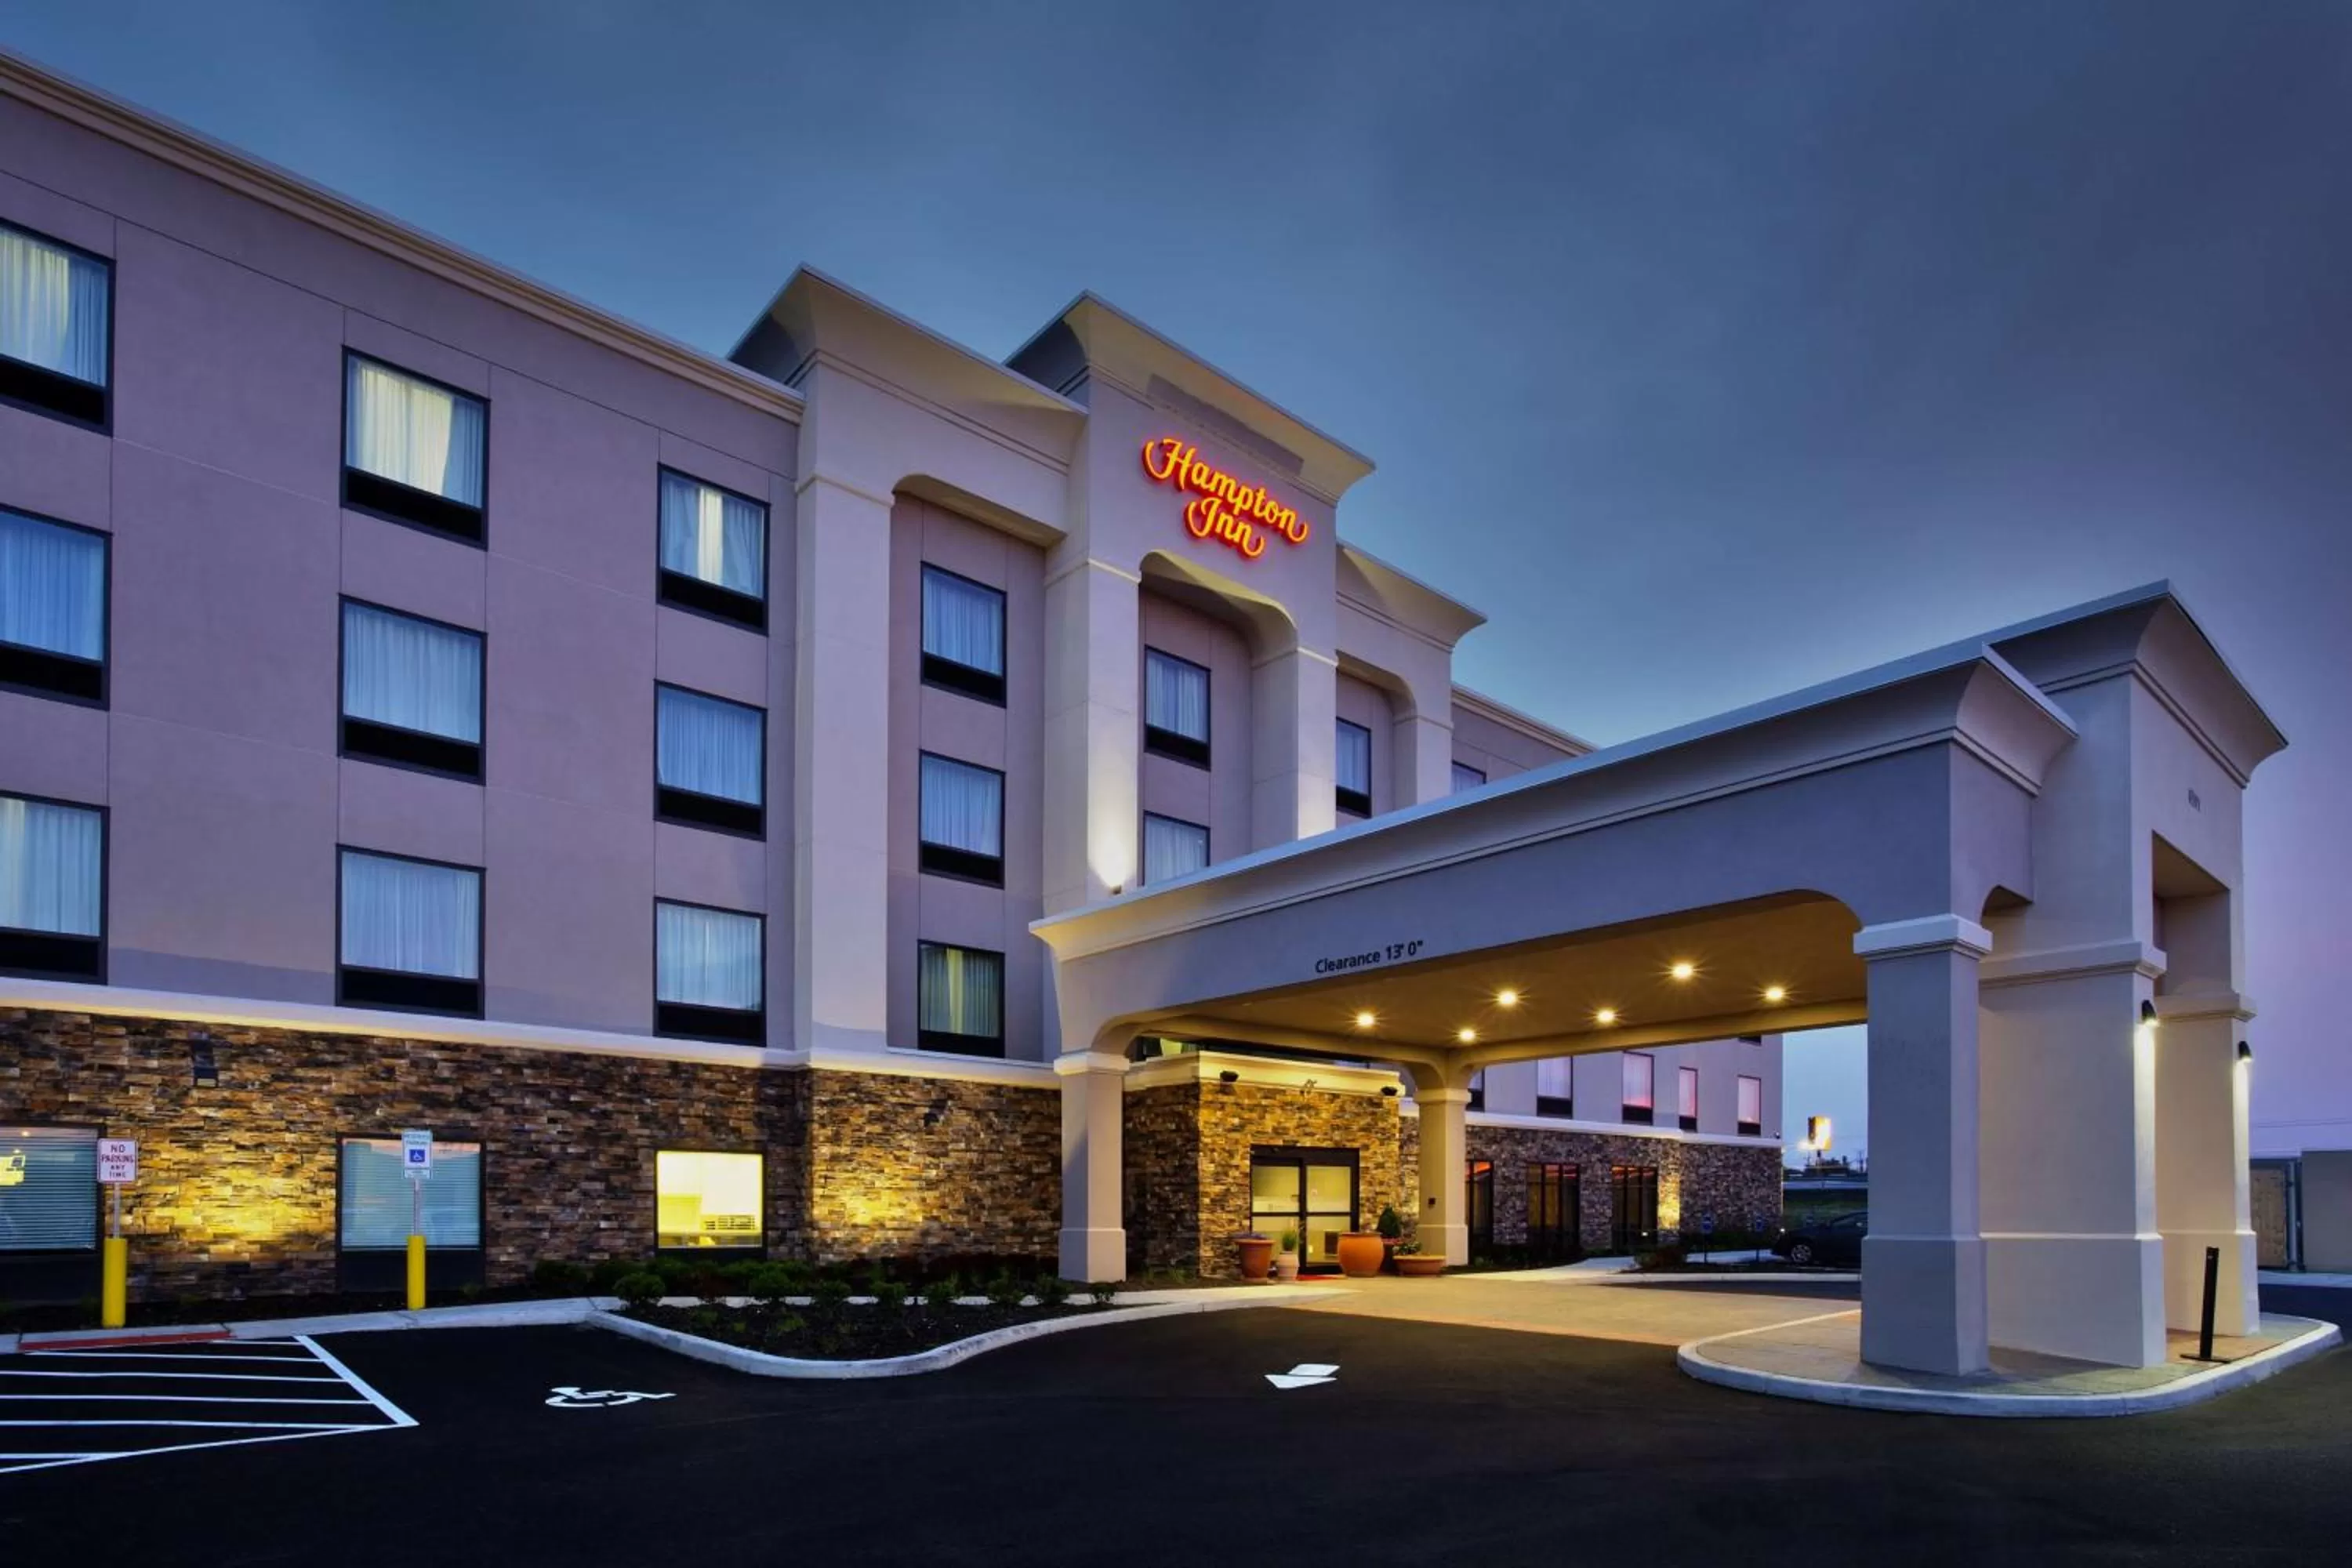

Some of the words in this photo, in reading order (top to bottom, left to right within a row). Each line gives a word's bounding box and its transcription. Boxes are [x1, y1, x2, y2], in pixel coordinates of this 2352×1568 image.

[1143, 437, 1308, 543] Hampton
[1186, 496, 1265, 558] Inn
[1315, 950, 1381, 974] Clearance
[101, 1154, 134, 1163] PARKING
[111, 1144, 125, 1153] NO
